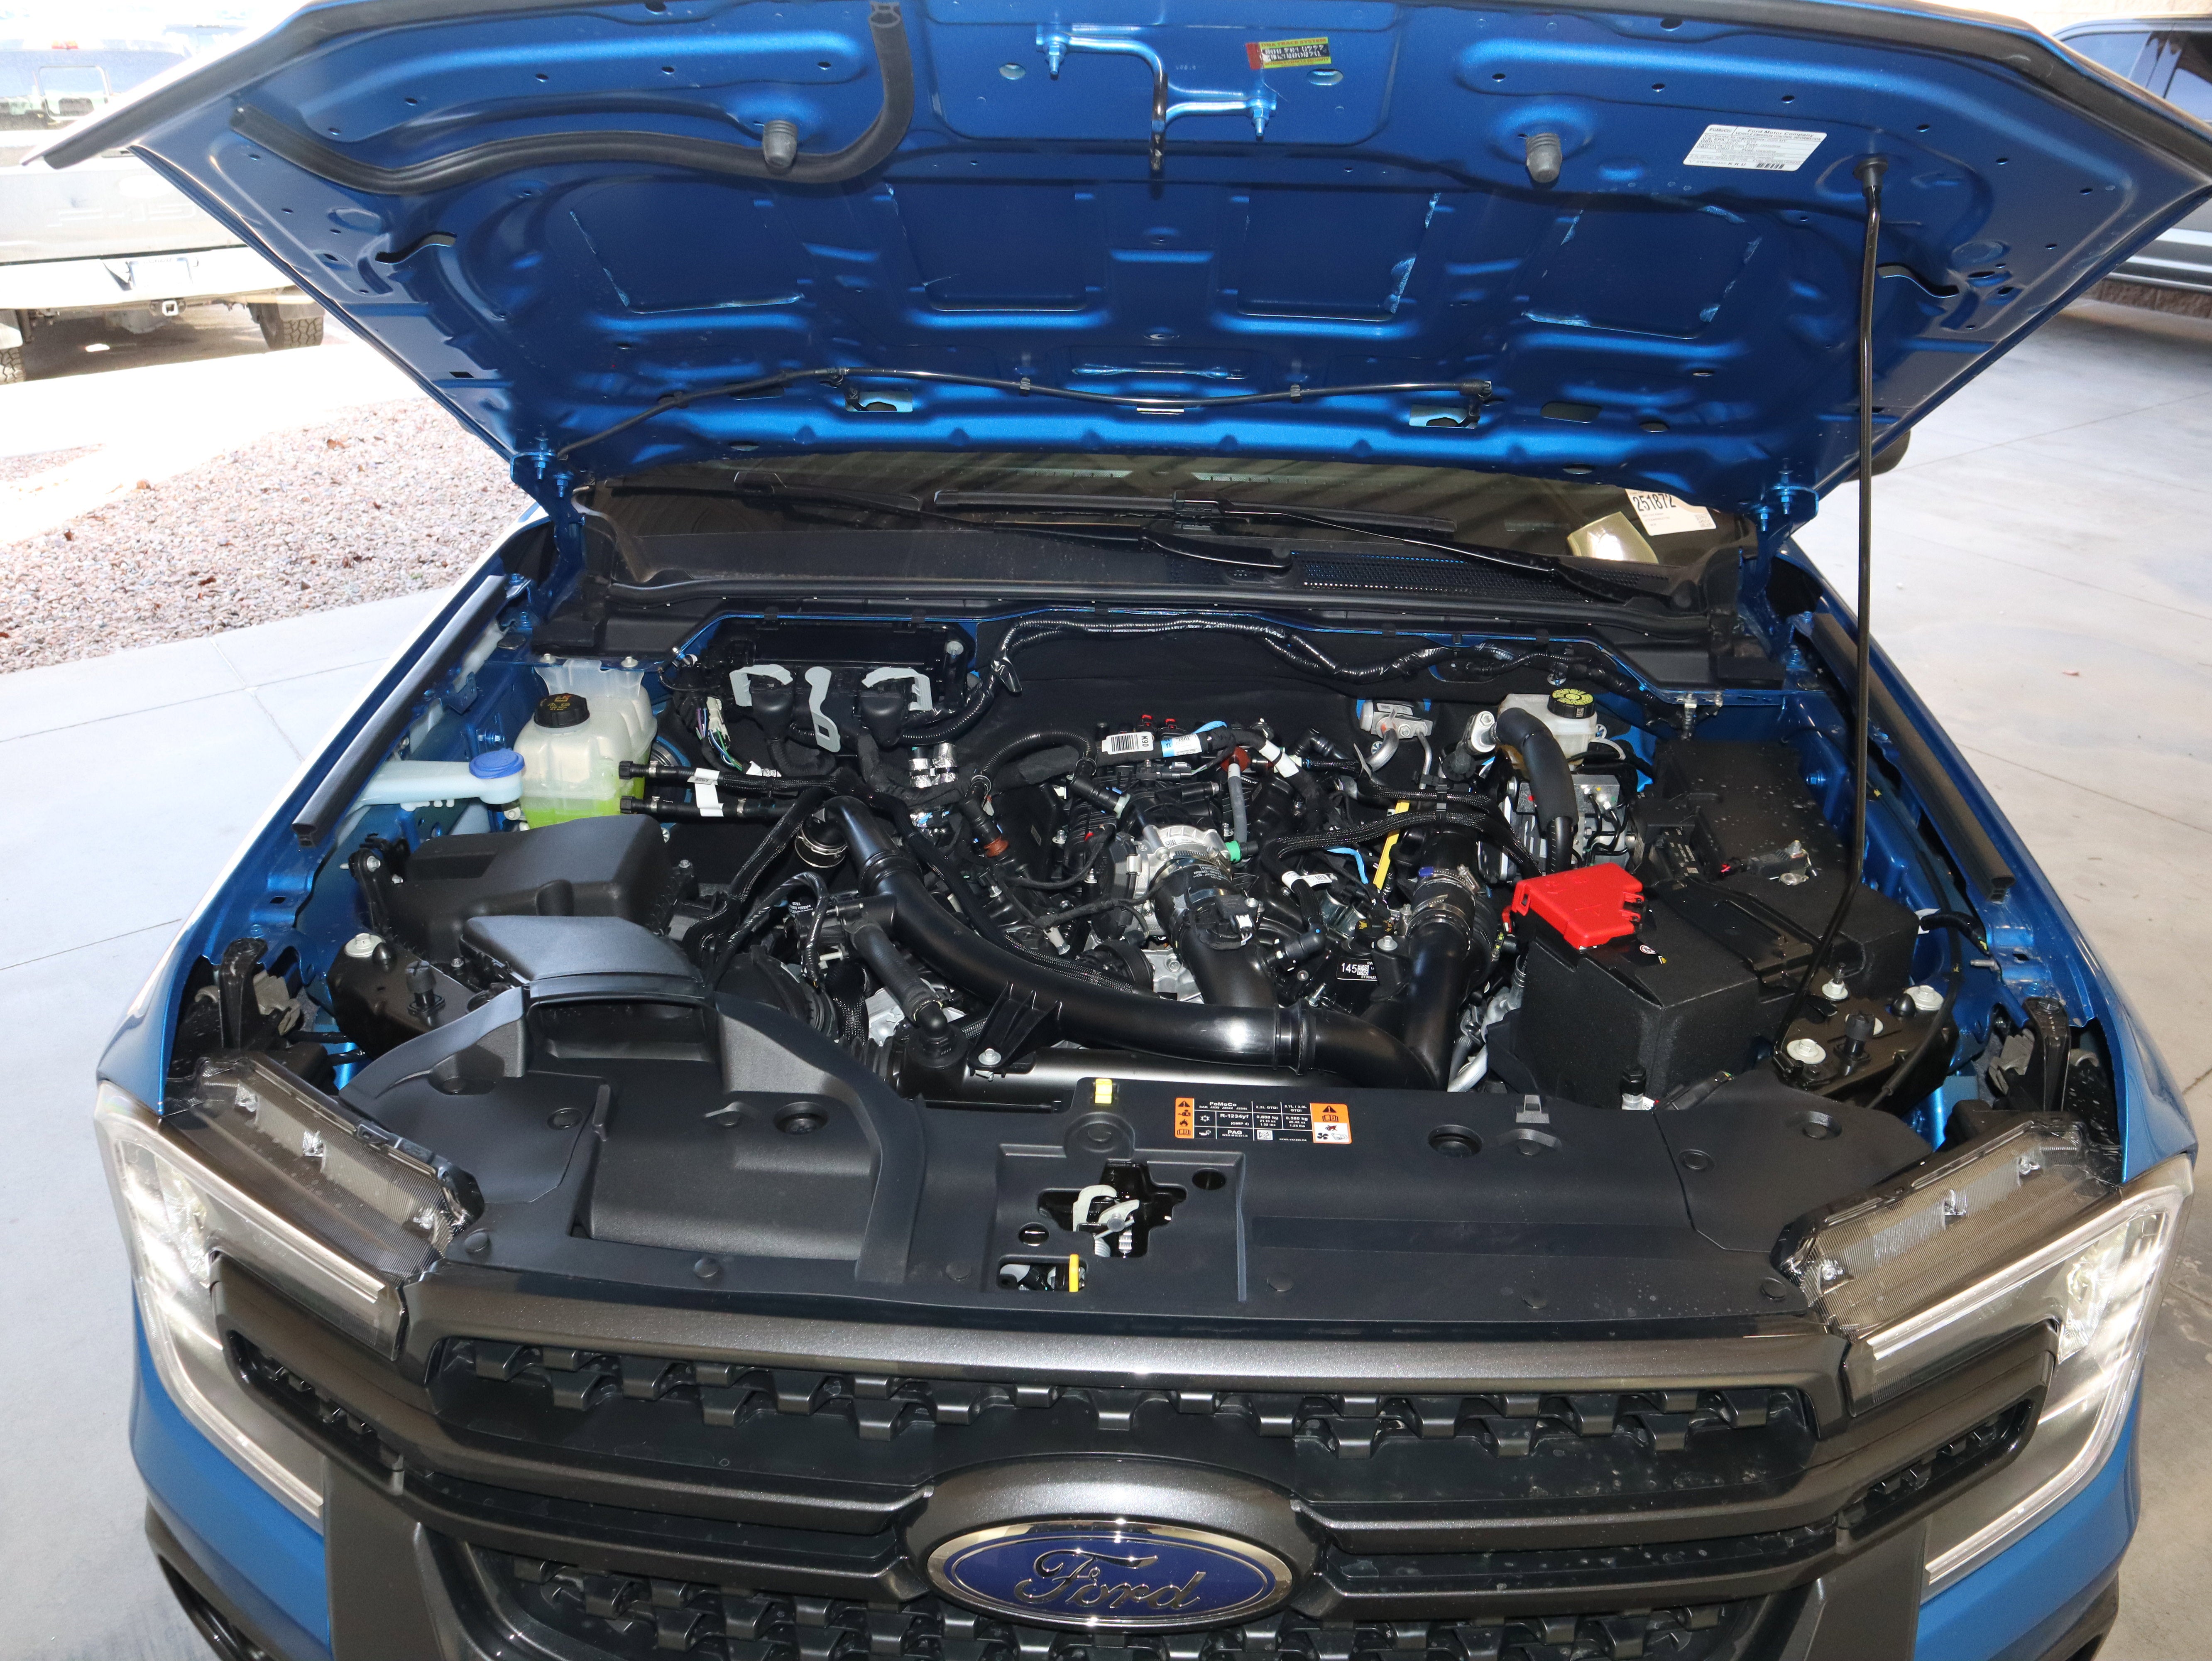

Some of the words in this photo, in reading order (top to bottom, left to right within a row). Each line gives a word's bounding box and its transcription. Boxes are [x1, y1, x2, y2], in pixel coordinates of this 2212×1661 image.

[47, 203, 197, 227] F-15
[1633, 493, 1676, 512] 251872
[1341, 963, 1357, 973] 145
[1014, 1548, 1206, 1610] Ford
